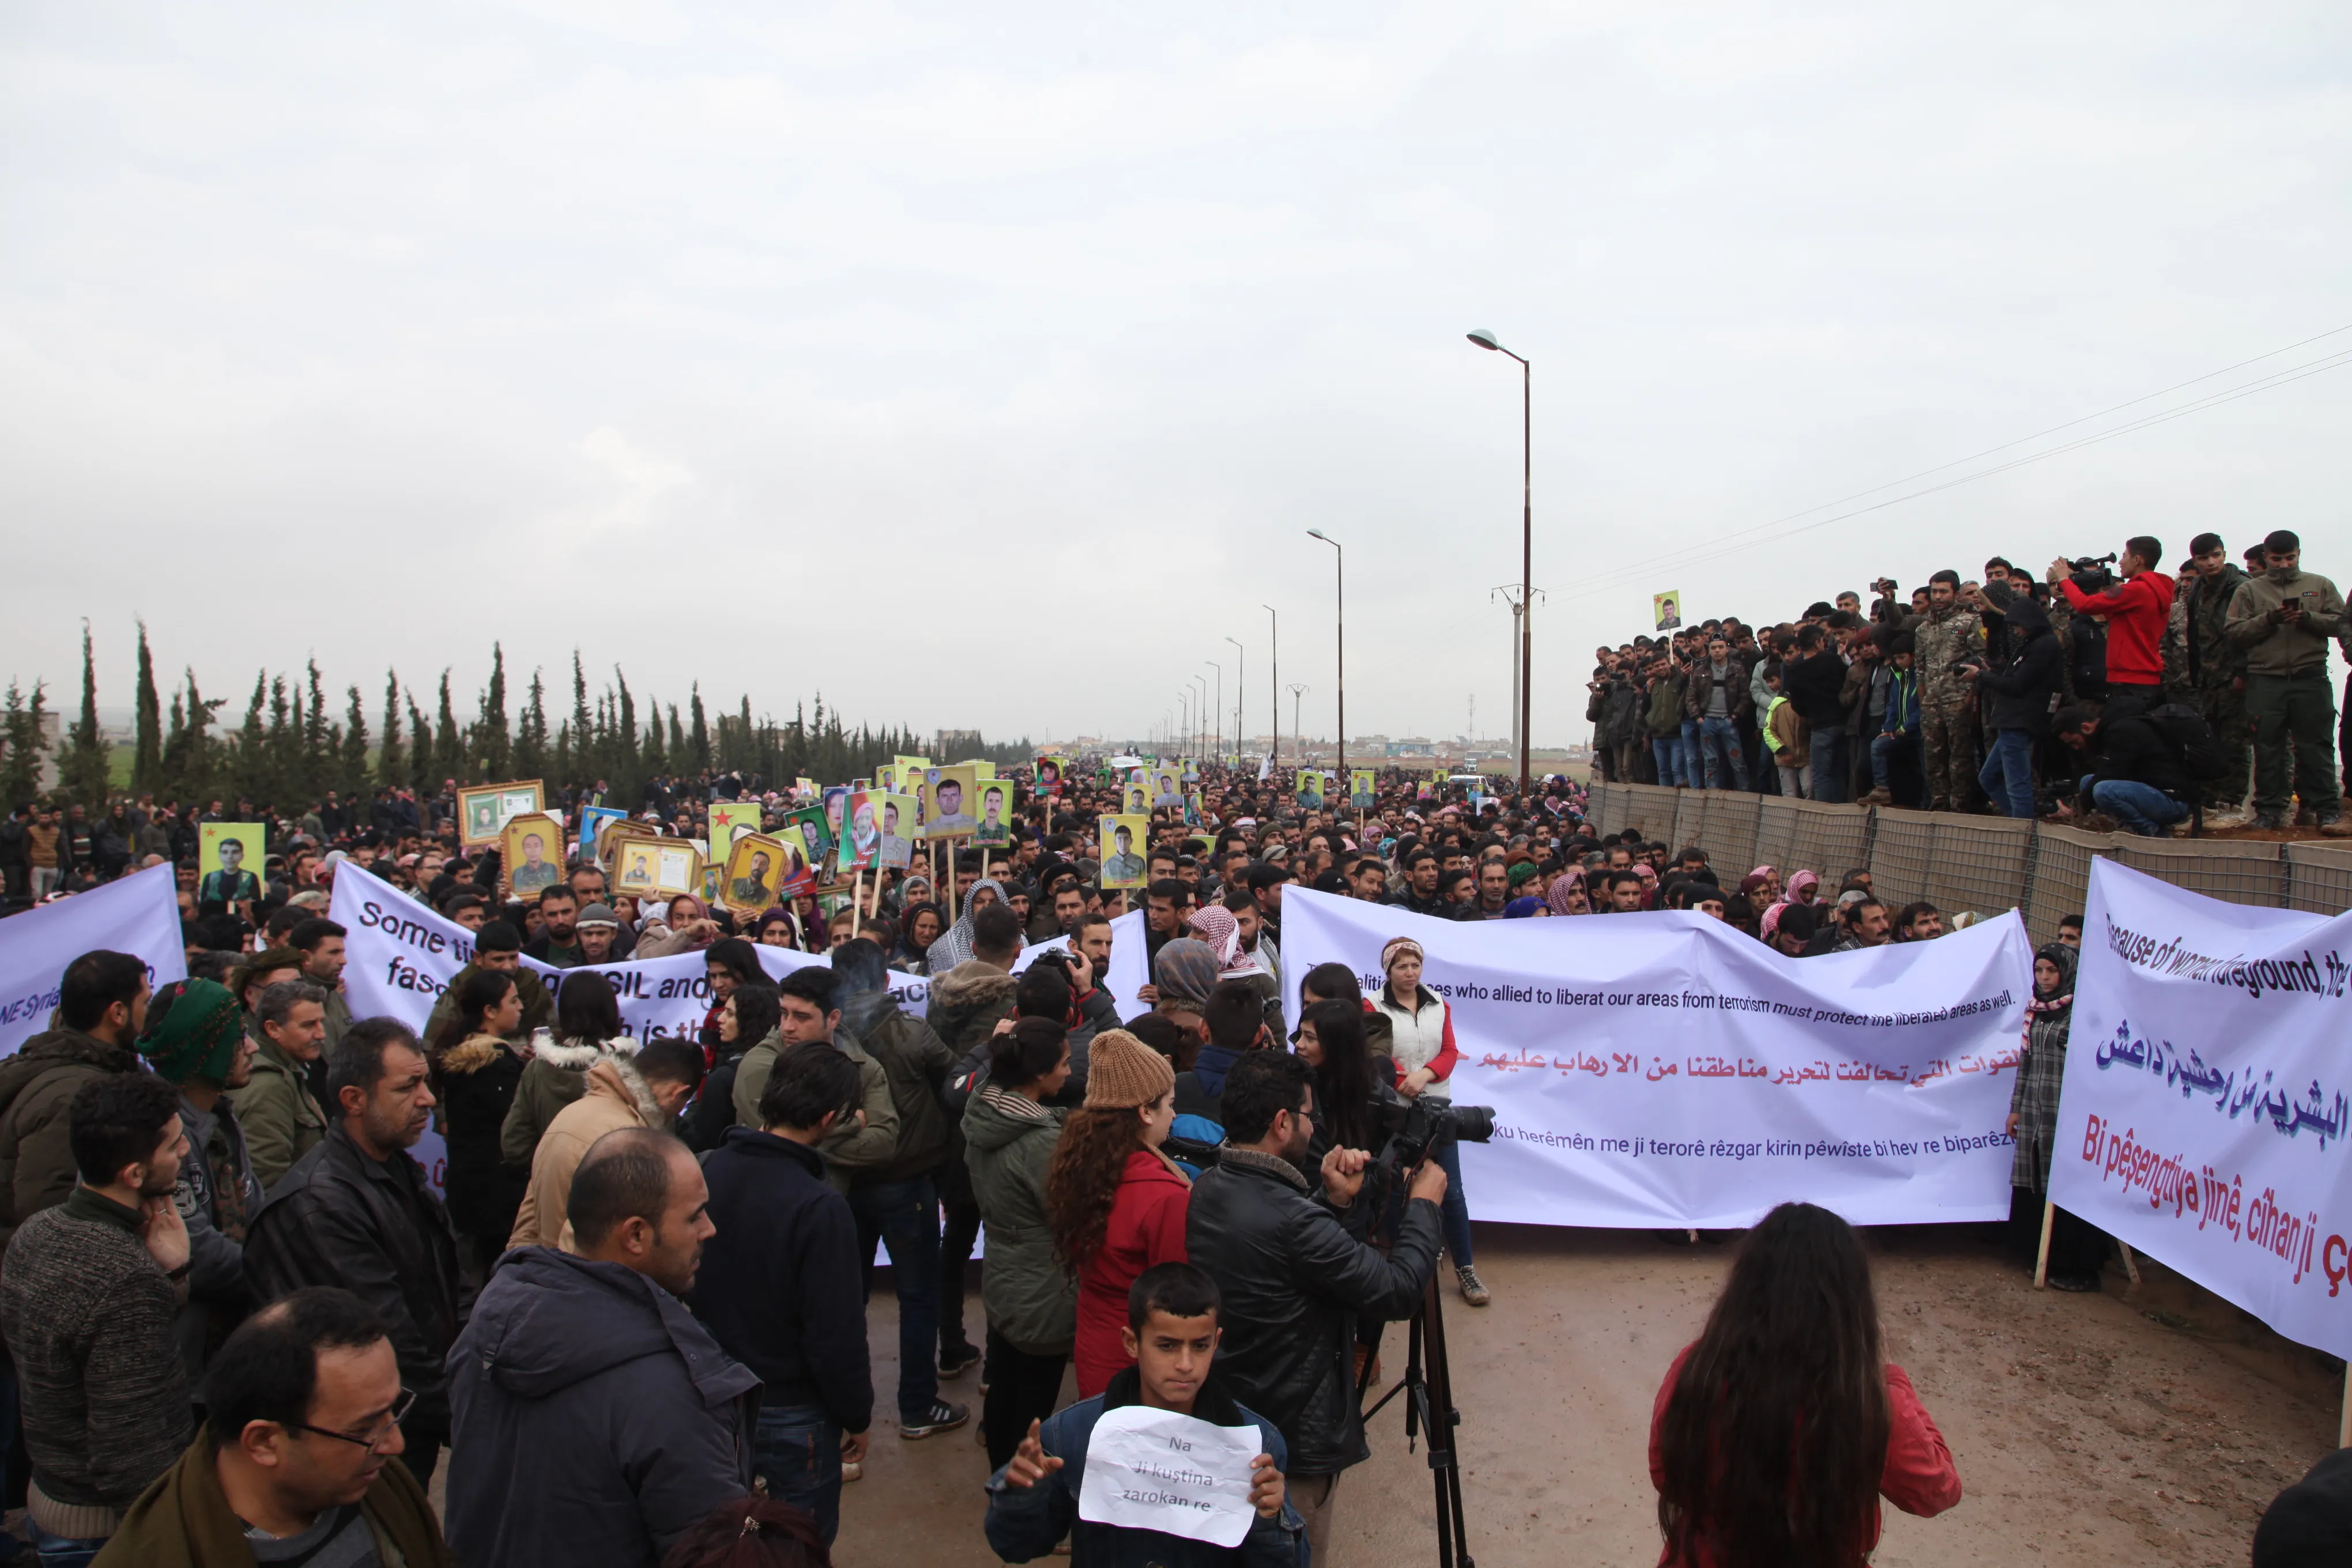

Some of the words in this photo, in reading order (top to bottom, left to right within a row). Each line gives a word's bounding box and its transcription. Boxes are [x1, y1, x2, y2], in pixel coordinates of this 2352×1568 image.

[359, 901, 446, 953] Some
[2106, 913, 2156, 966] Because
[2150, 936, 2183, 971] of
[2211, 950, 2325, 1001] foreground,
[2325, 950, 2351, 998] the
[597, 971, 650, 1000] SIL
[1456, 982, 1488, 1000] who
[1492, 985, 1533, 1003] allied
[1536, 989, 1552, 1004] to
[1556, 988, 1604, 1005] liberat
[1607, 993, 1634, 1006] our
[1636, 993, 1679, 1008] areas
[1682, 990, 1715, 1008] from
[1718, 993, 1770, 1013] terrorism
[1772, 1002, 1813, 1019] must
[1812, 1010, 1869, 1026] protect
[1871, 1014, 1893, 1027] the
[1893, 1007, 1947, 1026] liberated
[1950, 1001, 1978, 1019] areas
[1980, 998, 1991, 1012] as
[1992, 989, 2016, 1009] well.
[2096, 1019, 2163, 1072] داعش
[1476, 1047, 1547, 1073] عليهم
[1646, 1056, 1678, 1081] من
[1687, 1056, 1768, 1078] مناطقنا
[1770, 1060, 1830, 1085] لتحرير
[1835, 1060, 1909, 1081] تحالفت
[1910, 1059, 1952, 1087] التي
[1958, 1048, 2019, 1075] لقوات
[2163, 1039, 2234, 1109] وحشية
[2230, 1066, 2257, 1115] من
[2253, 1069, 2348, 1147] البشرية
[1494, 1121, 1514, 1139] ku
[1517, 1127, 1595, 1151] herêmên
[1600, 1137, 1630, 1152] me
[1633, 1137, 1645, 1157] ji
[1649, 1139, 1705, 1156] terorê
[1709, 1139, 1762, 1160] rêzgar
[1766, 1139, 1801, 1156] kirin
[1805, 1140, 1872, 1159] pêwîste
[1873, 1140, 1889, 1156] bi
[1889, 1140, 1918, 1156] hev
[1923, 1140, 1940, 1154] re
[2082, 1114, 2108, 1166] Bi
[2103, 1128, 2199, 1219] pêşengtiya
[2198, 1164, 2242, 1243] jinê,
[2247, 1187, 2301, 1264] cîhan
[2293, 1211, 2317, 1285] ji
[1169, 1437, 1192, 1452] Na
[1134, 1461, 1148, 1474] Ji
[1152, 1463, 1213, 1487] kuştina
[1123, 1490, 1189, 1507] zarokan
[1194, 1501, 1211, 1512] re
